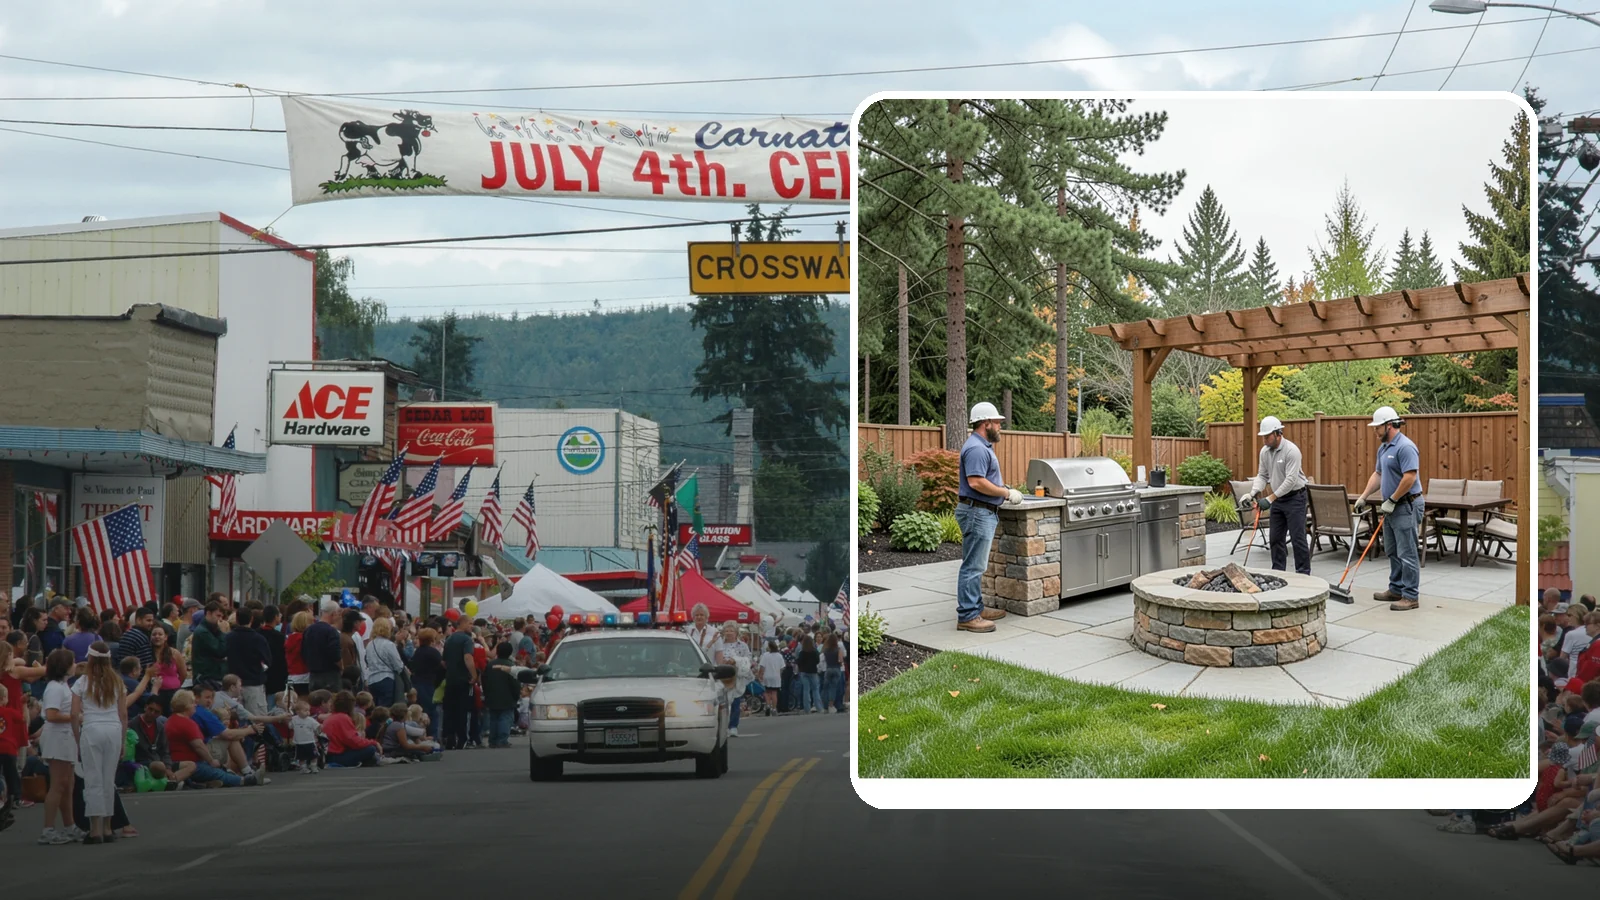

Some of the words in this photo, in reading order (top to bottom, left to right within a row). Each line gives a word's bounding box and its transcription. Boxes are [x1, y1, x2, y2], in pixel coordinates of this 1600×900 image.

[481, 141, 605, 192] JULY
[632, 149, 746, 198] 4th.
[283, 380, 373, 419] ACE
[405, 409, 452, 422] CEDAR
[283, 421, 370, 436] Hardware
[416, 428, 476, 447] Coca-Cola
[353, 467, 384, 480] Simpl
[95, 485, 124, 495] Vincent
[126, 486, 135, 495] de
[137, 486, 155, 495] Paul
[81, 503, 154, 522] THT
[688, 526, 741, 535] CRNATION
[699, 535, 730, 543] GLASS
